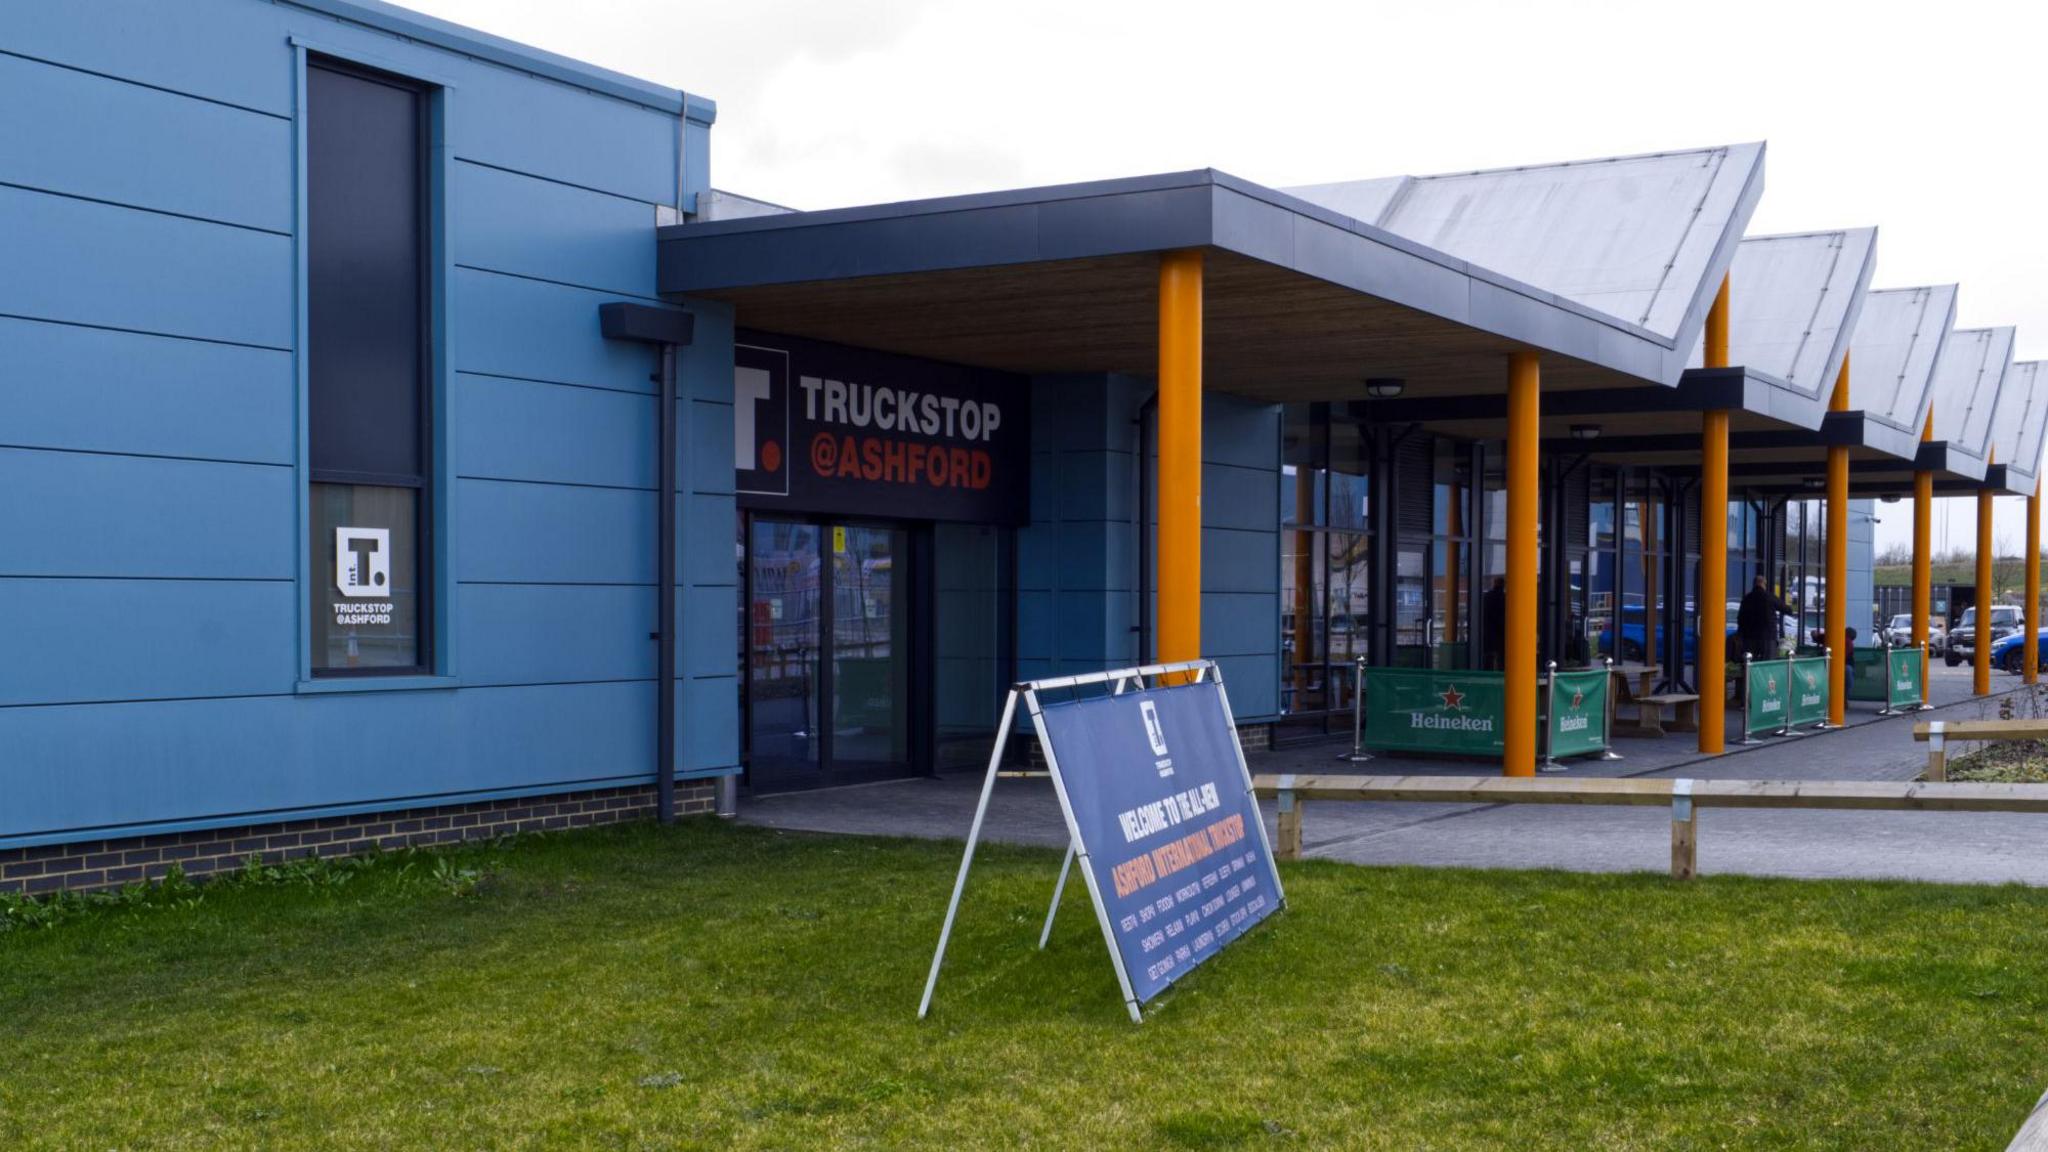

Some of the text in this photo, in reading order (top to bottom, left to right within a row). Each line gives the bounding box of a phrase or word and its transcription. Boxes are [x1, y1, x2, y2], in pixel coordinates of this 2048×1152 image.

[800, 375, 1001, 441] TRUCKSTOP
[811, 431, 992, 489] @ASHFORD
[334, 603, 394, 613] TRUCKSTOP
[336, 614, 391, 624] @ASHFORD
[1410, 712, 1493, 731] Heineken
[1118, 800, 1169, 843] WELCOME
[1163, 796, 1181, 826] TO
[1112, 853, 1156, 899] ASHFORD
